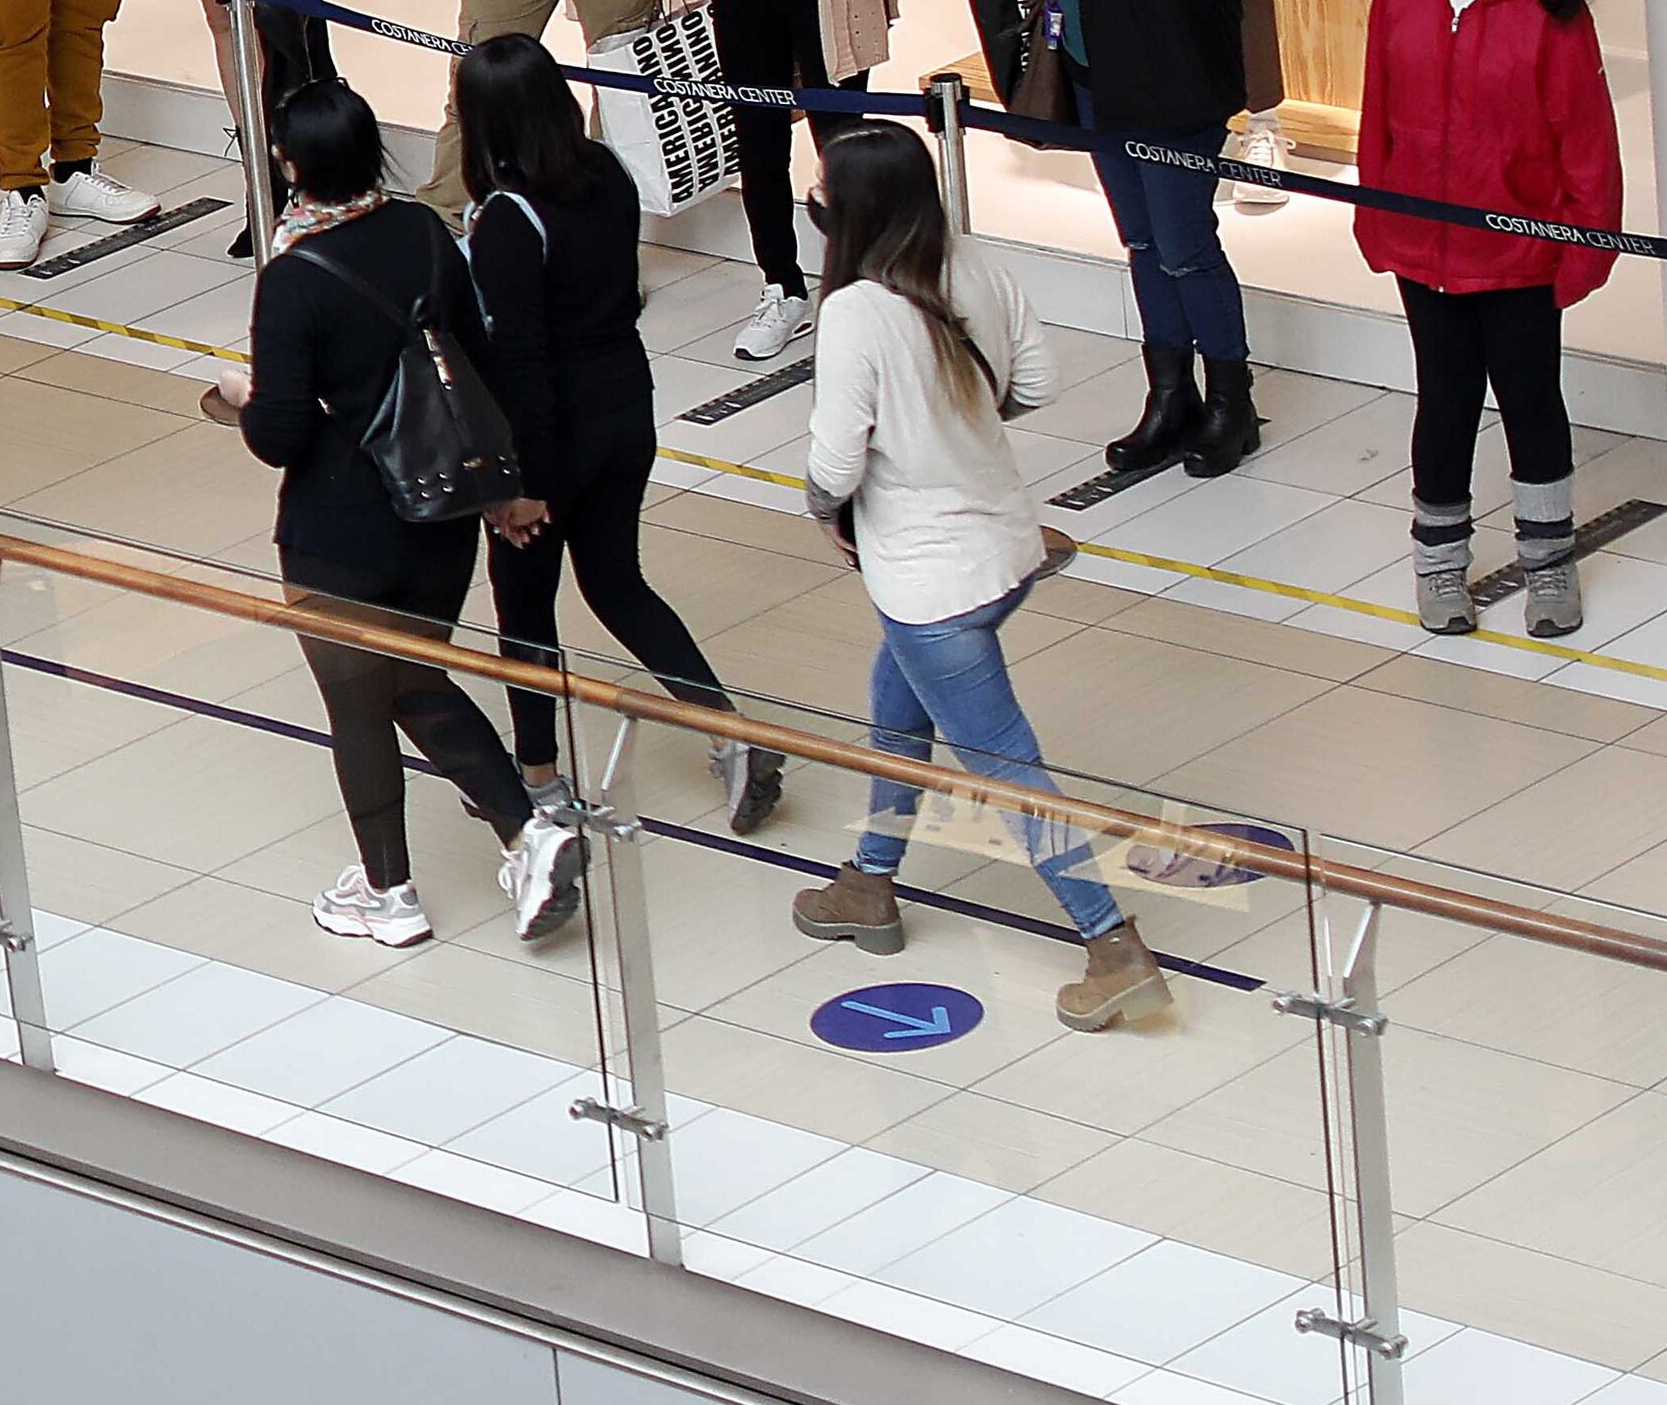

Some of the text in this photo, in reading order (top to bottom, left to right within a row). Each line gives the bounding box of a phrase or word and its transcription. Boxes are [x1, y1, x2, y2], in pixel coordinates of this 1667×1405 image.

[371, 18, 451, 52] COSTANERA
[653, 78, 797, 106] COSTANERA CENTER
[1125, 141, 1283, 188] COSTANERA CENTER
[1485, 213, 1656, 256] COSTANERA CENTER
